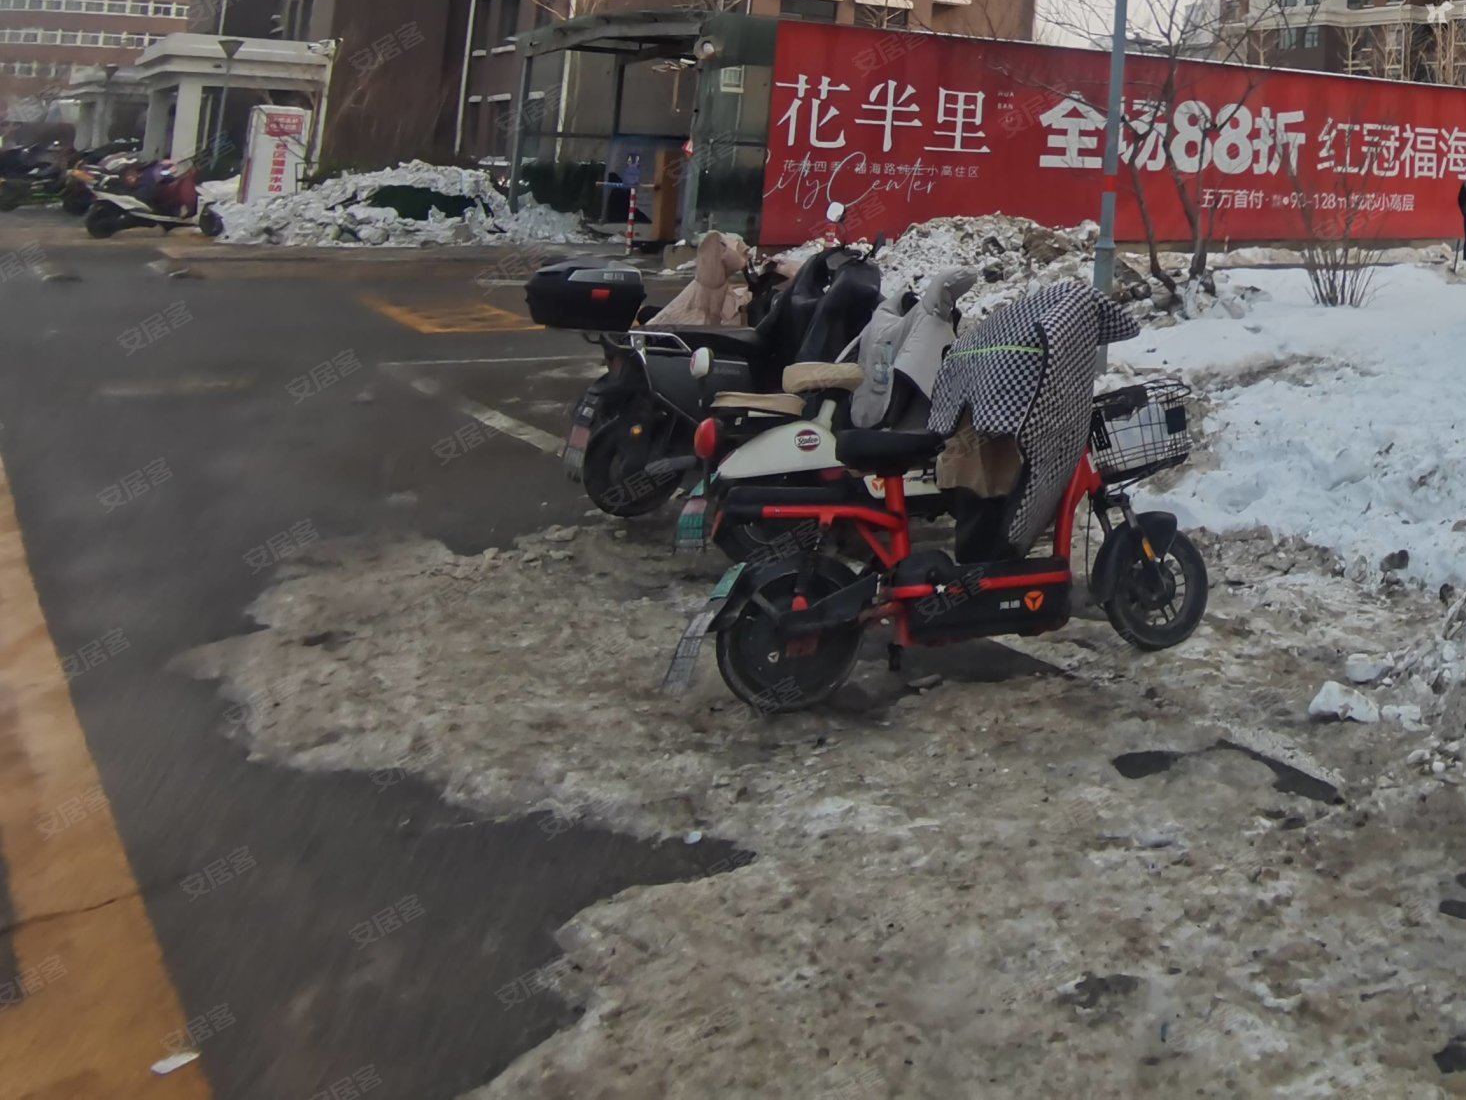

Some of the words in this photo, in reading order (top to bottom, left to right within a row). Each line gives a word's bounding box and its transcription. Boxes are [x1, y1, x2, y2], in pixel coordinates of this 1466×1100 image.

[775, 74, 991, 152] 花半里
[826, 151, 937, 207] Center
